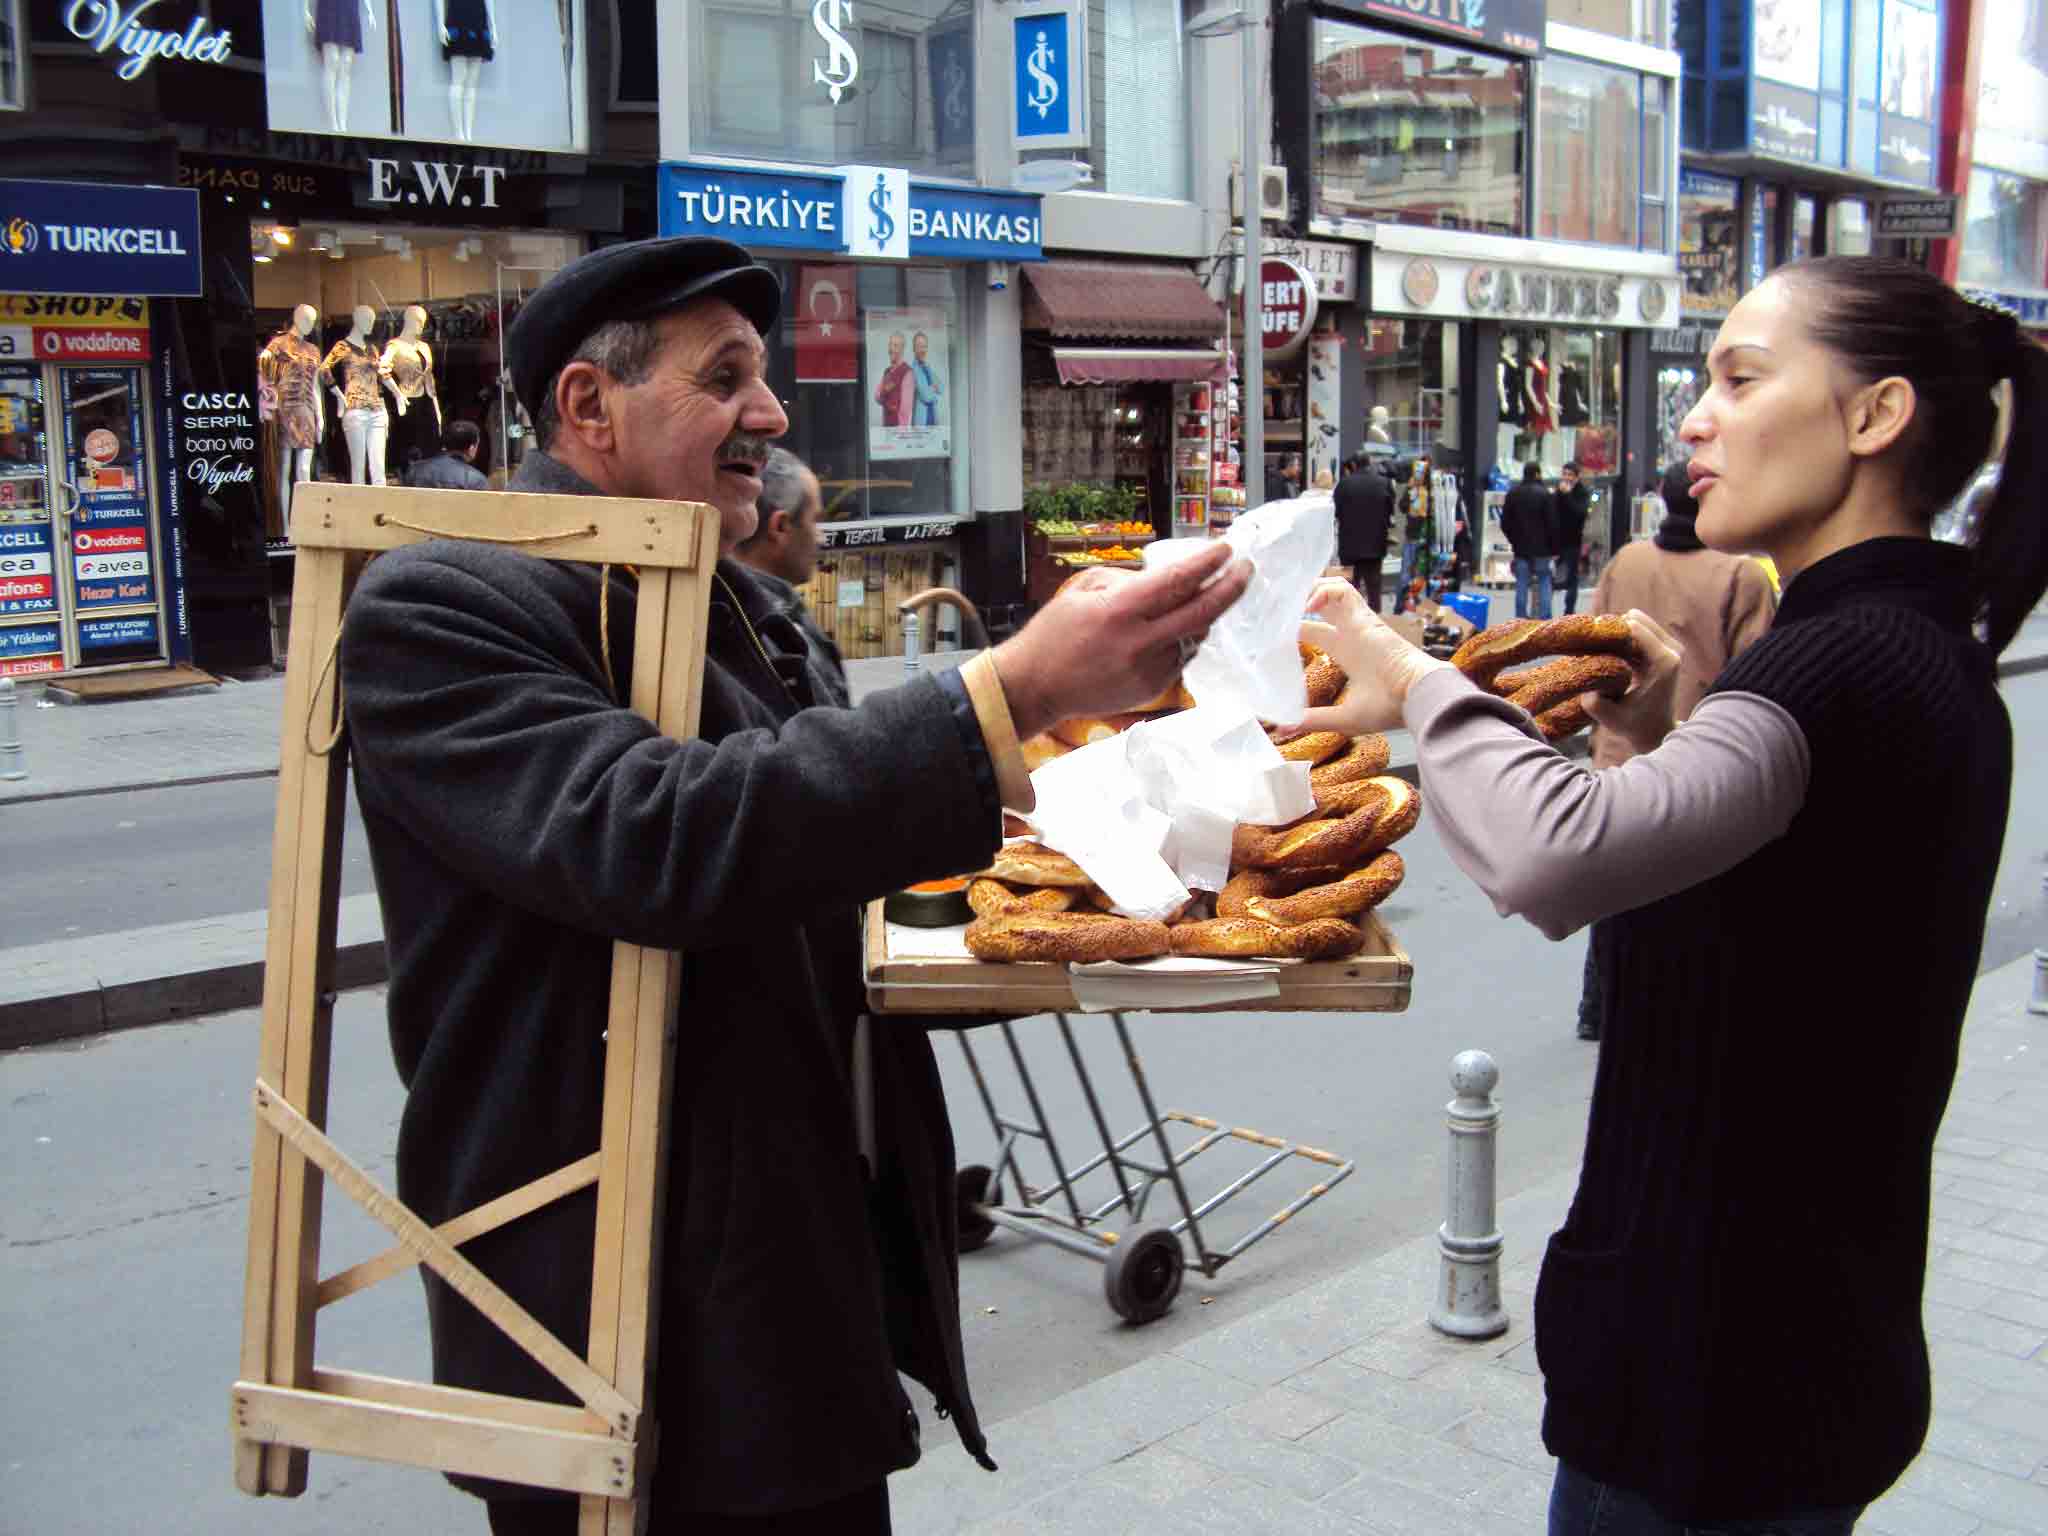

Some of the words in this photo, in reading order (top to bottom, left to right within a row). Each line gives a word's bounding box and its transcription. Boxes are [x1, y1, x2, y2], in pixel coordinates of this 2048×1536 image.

[67, 0, 231, 80] Viyolet
[367, 157, 505, 208] E.W.T
[678, 185, 835, 231] TÜRKİYE
[908, 208, 1039, 245] BANKASI
[44, 224, 187, 255] TURKCELL
[1262, 281, 1301, 305] ERT
[1262, 307, 1300, 333] ÜFE
[65, 332, 141, 353] vodafone
[183, 393, 251, 409] CASCA
[184, 414, 253, 429] SERPİL
[187, 455, 254, 495] Viyolet
[94, 507, 143, 519] TURKCELL
[94, 535, 143, 548] vodafone
[98, 560, 143, 572] avea
[24, 599, 53, 608] FAX
